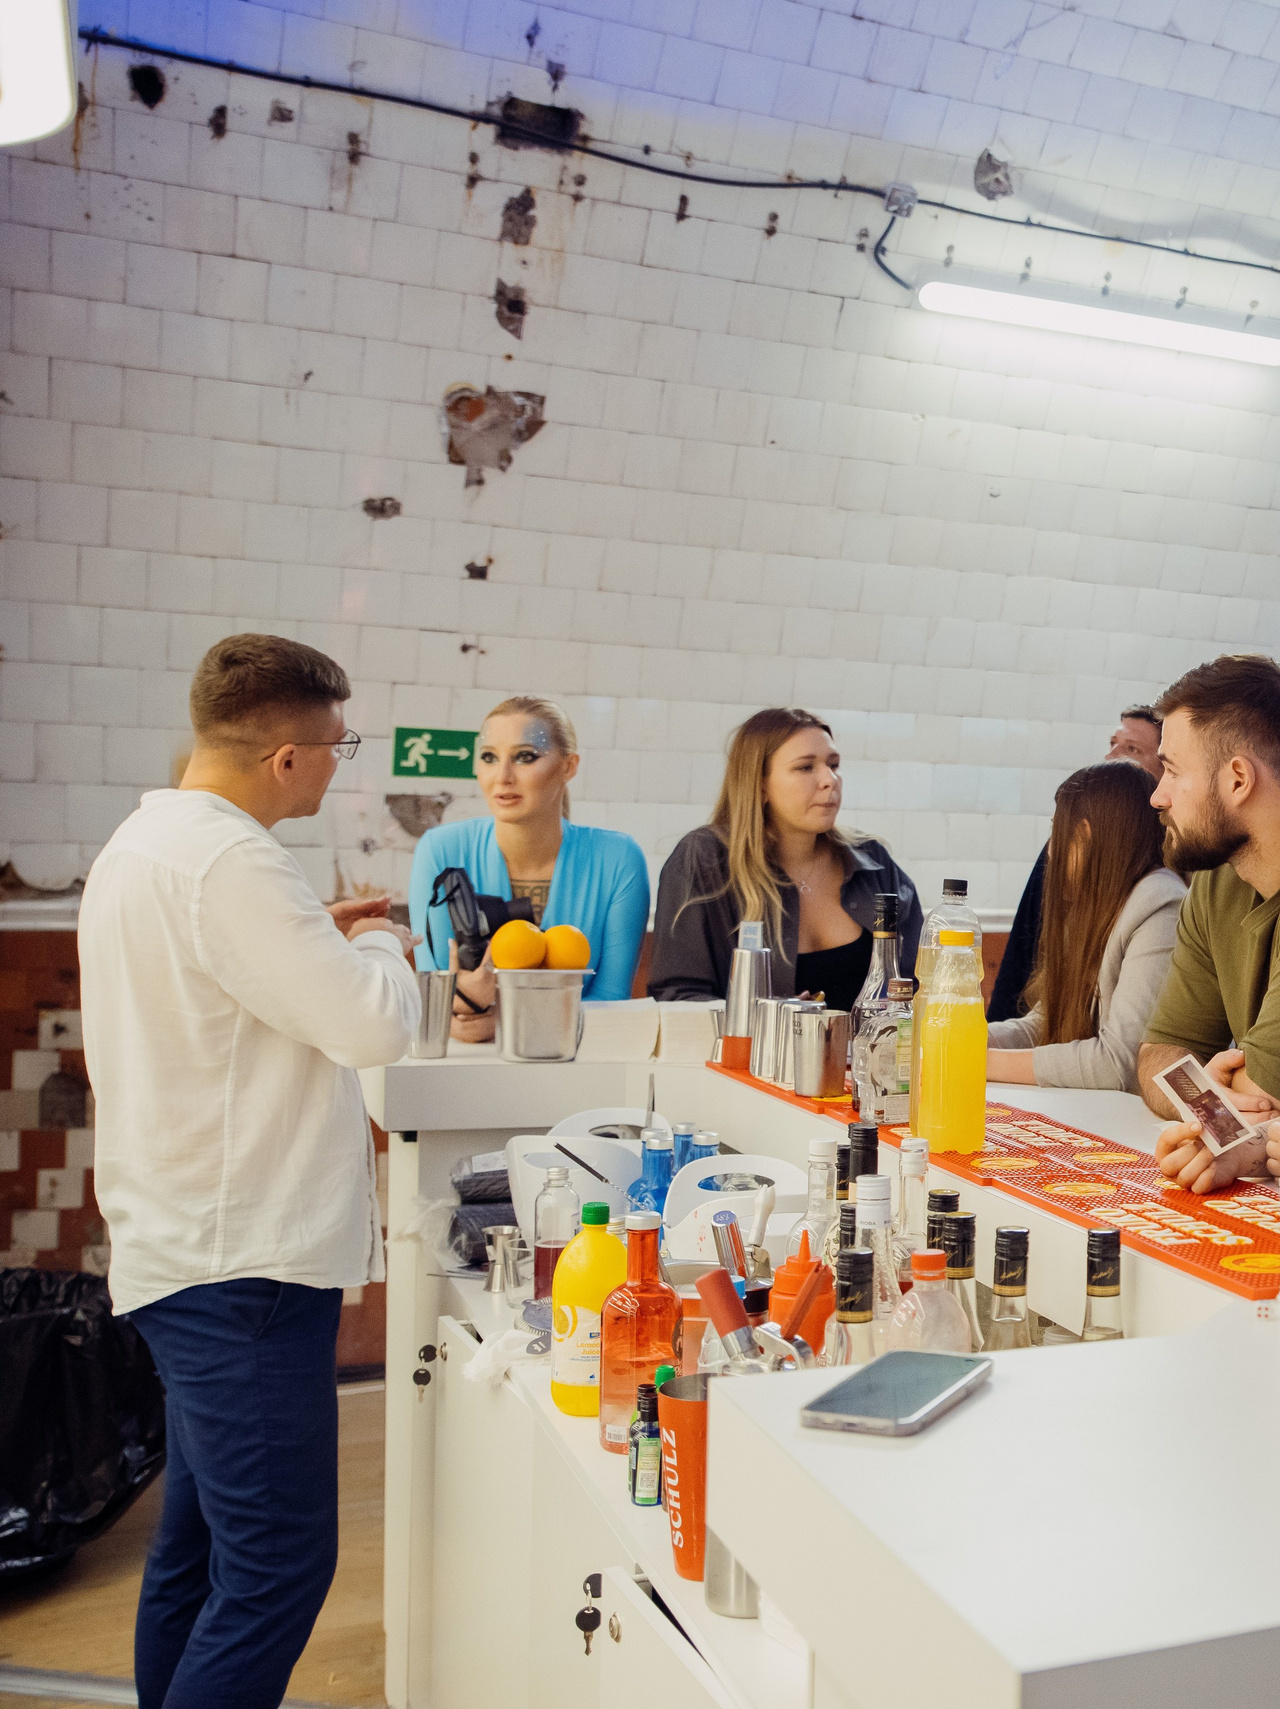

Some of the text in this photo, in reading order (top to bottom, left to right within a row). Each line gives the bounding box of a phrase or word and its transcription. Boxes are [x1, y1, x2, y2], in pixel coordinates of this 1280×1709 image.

[1088, 1207, 1200, 1246] FRUKO
[1121, 1201, 1255, 1246] SCHULZ
[662, 1427, 684, 1548] SCHULZ
